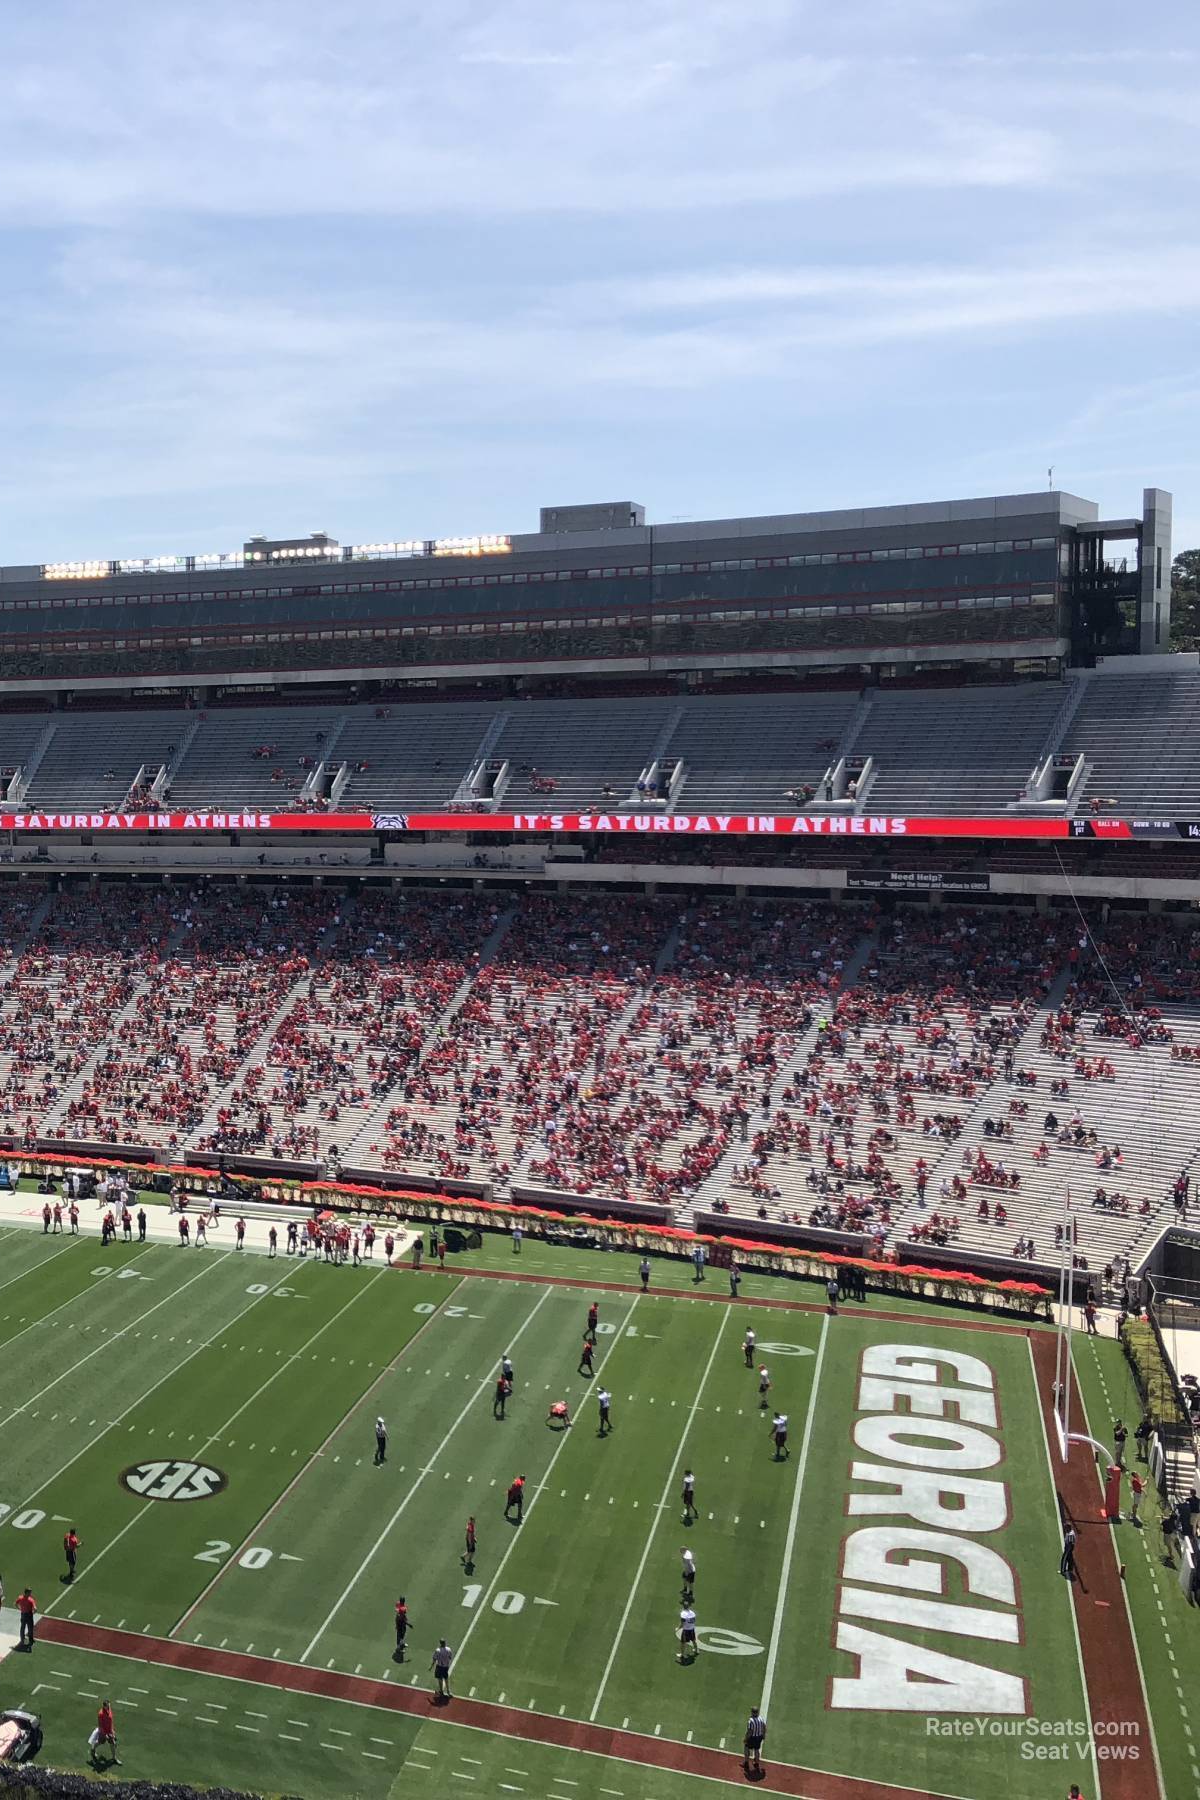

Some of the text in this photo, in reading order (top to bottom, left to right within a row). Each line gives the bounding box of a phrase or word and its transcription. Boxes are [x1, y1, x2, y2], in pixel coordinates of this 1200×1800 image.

[14, 815, 135, 828] SATURDAY
[148, 816, 171, 827] IN
[183, 815, 271, 827] ATHENS
[513, 815, 907, 833] IT'S SATURDAY IN ATHENS
[126, 1461, 221, 1499] SEC
[831, 1343, 1028, 1715] GEORGIA
[192, 1539, 274, 1570] 20
[460, 1584, 526, 1615] 10
